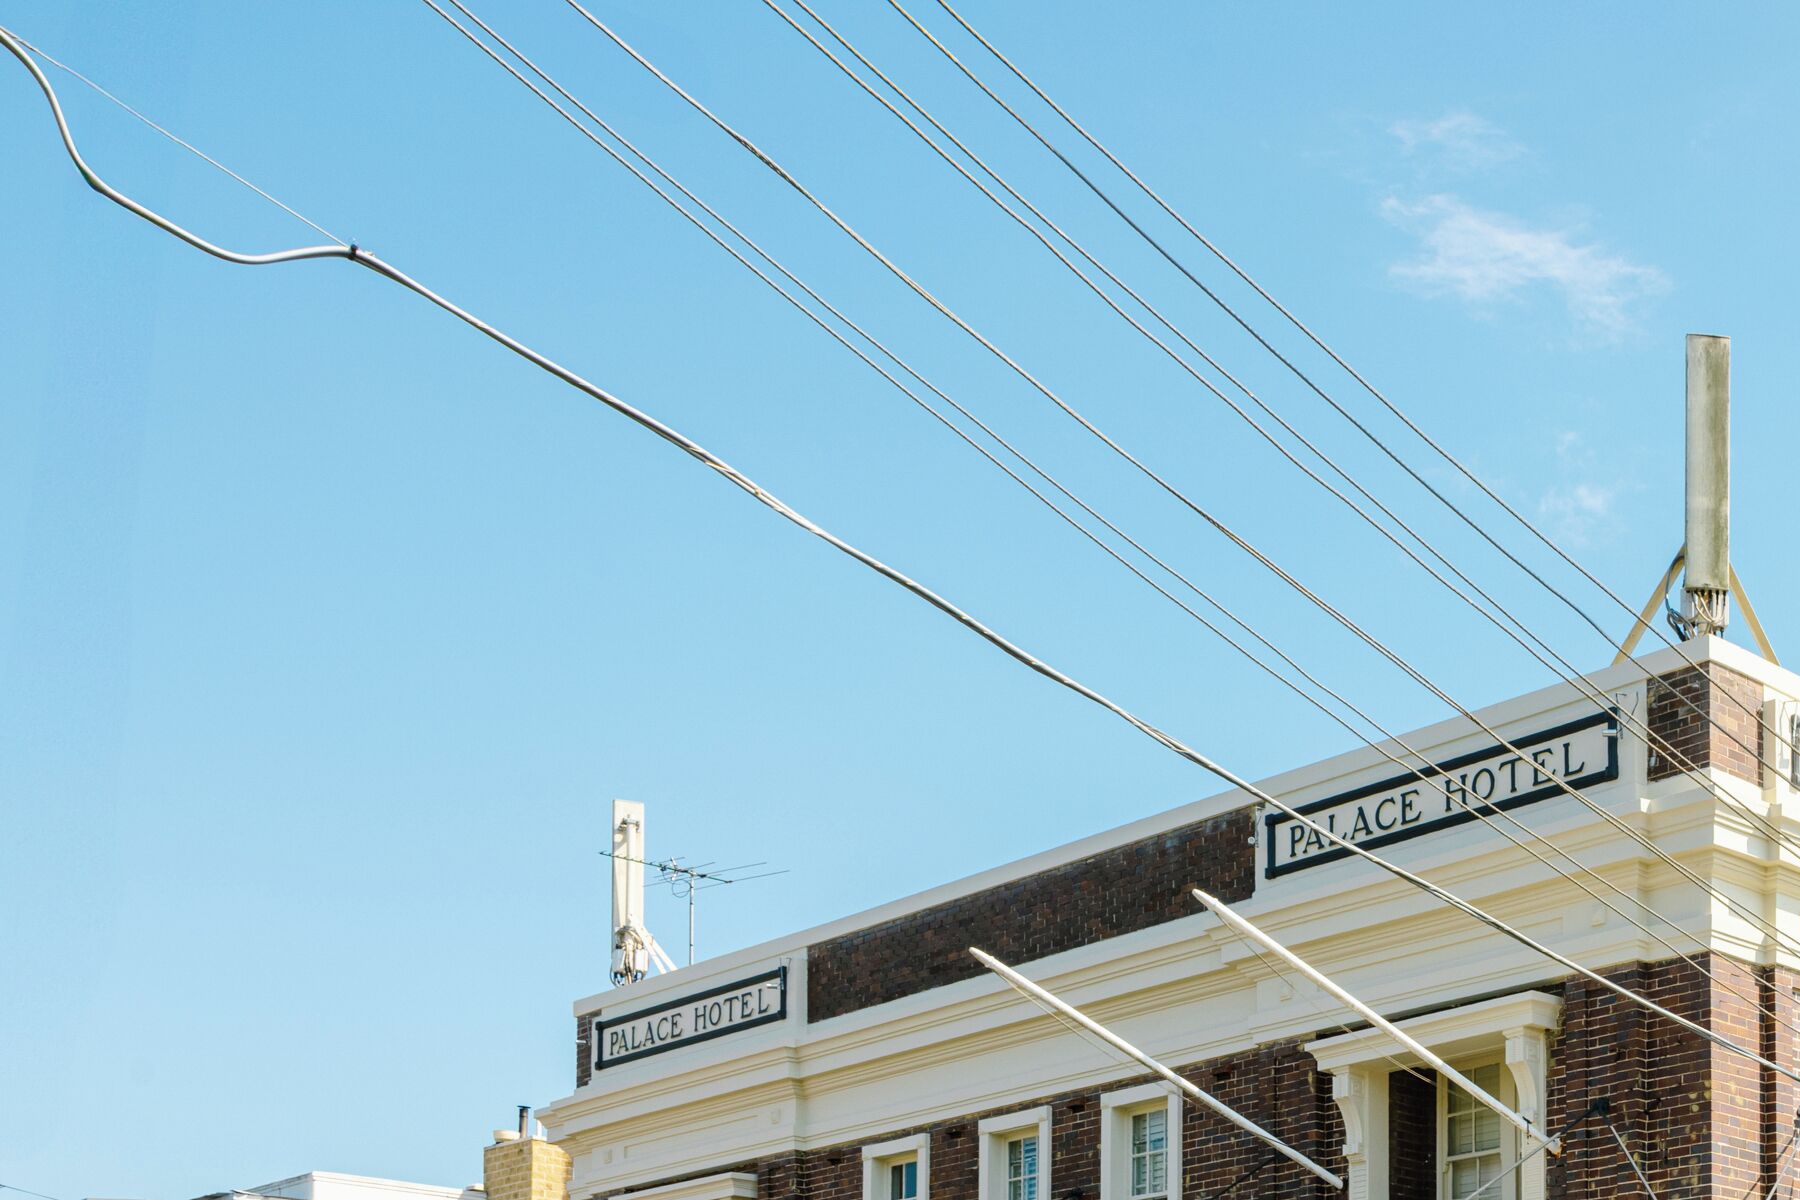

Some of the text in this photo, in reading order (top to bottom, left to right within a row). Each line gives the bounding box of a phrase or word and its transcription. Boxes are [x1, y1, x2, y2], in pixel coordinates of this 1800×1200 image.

[1289, 742, 1585, 858] PALACE HOTEL
[609, 988, 770, 1056] PALACE HOTEL
